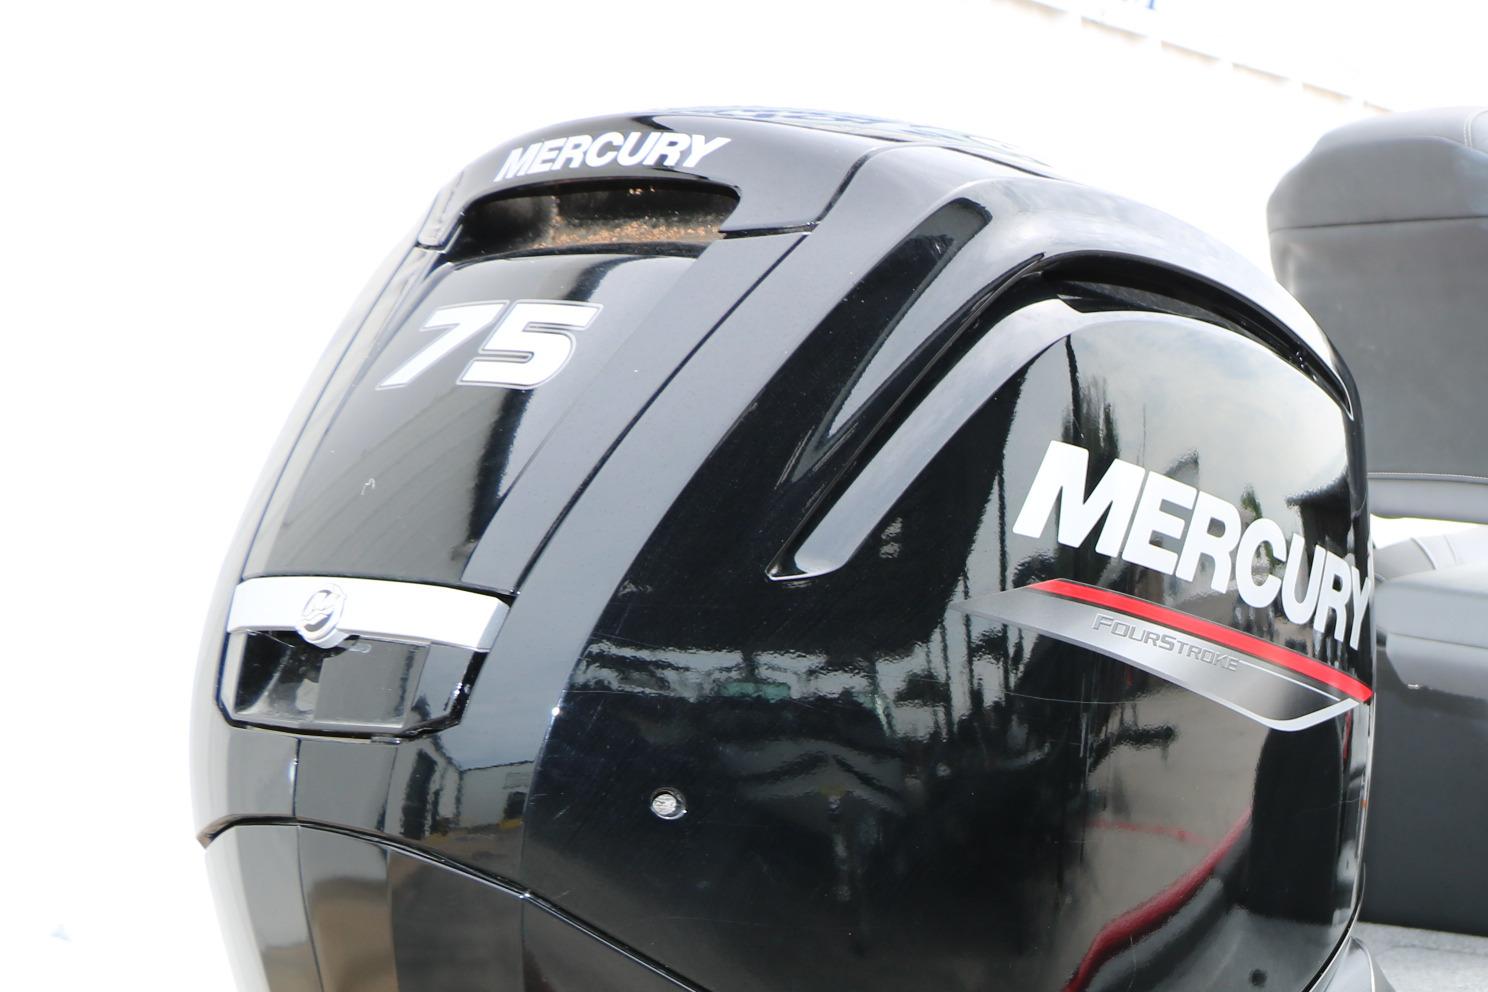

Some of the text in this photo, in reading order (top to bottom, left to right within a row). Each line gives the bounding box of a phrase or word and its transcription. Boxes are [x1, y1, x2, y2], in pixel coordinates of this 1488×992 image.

[494, 131, 731, 183] MERCURY
[376, 299, 603, 391] 75
[1013, 439, 1370, 651] MERCURY
[1092, 613, 1240, 672] FOURSTROKE
